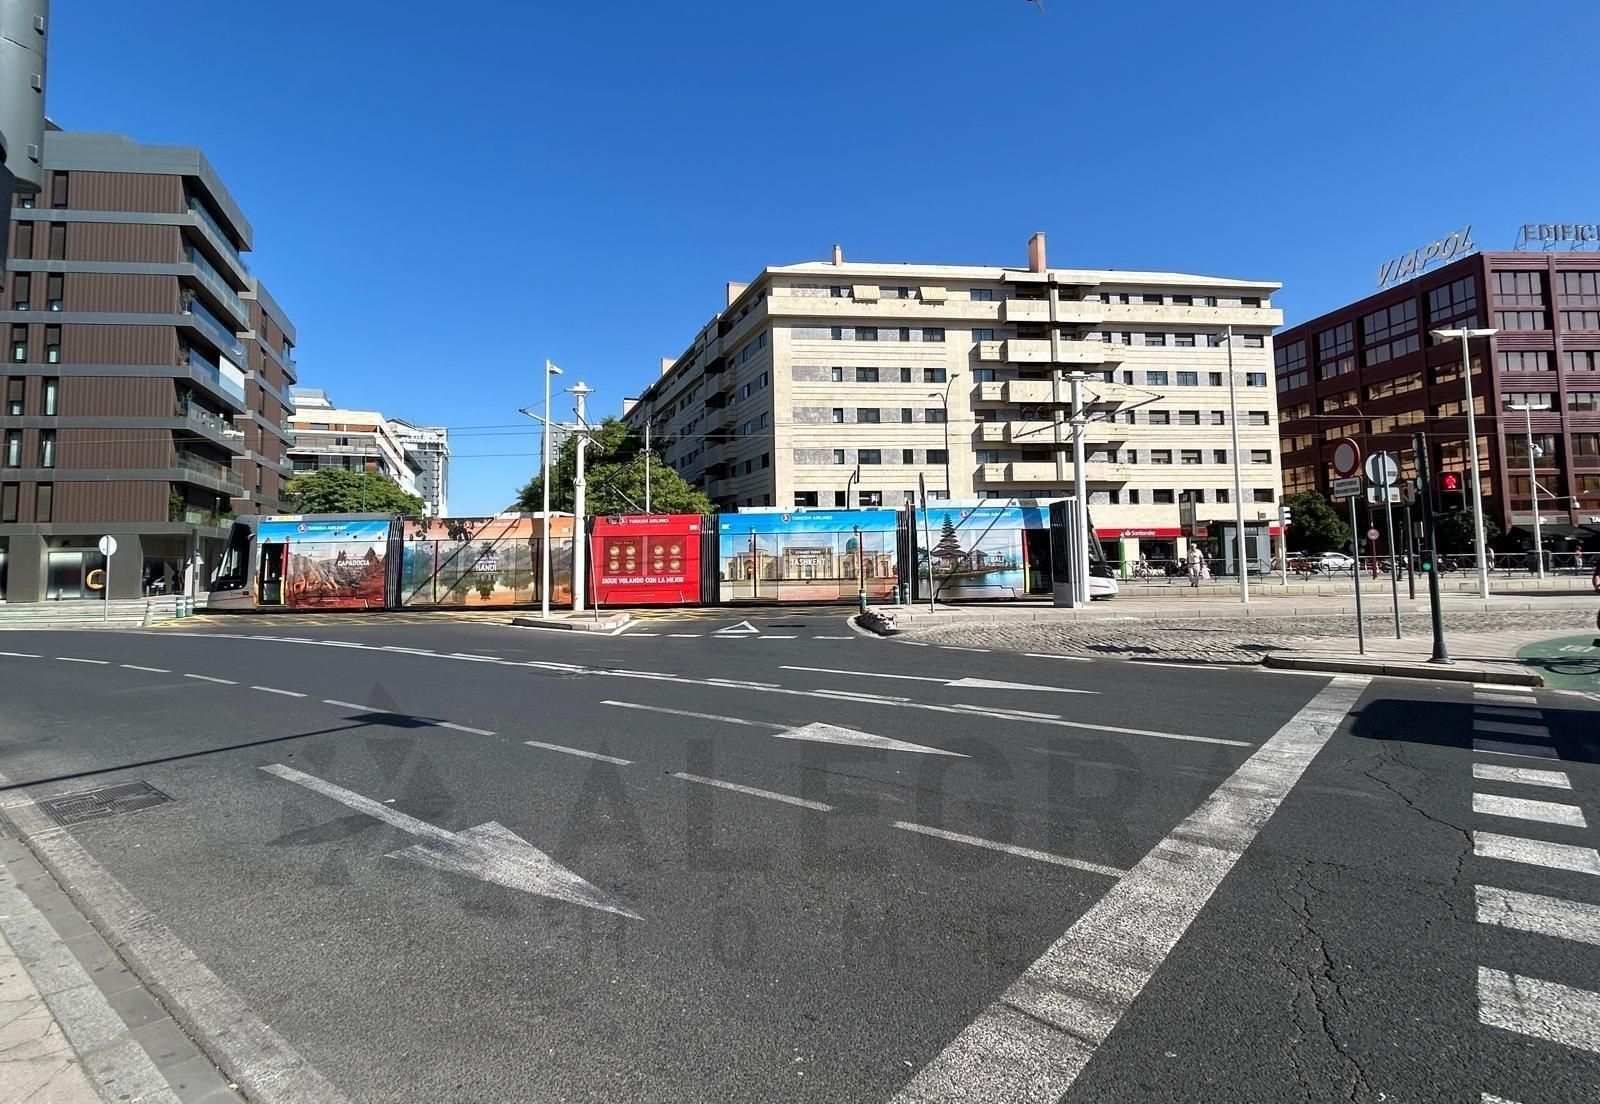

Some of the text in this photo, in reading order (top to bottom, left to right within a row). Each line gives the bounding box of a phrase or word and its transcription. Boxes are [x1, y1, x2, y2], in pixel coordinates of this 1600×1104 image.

[1376, 225, 1473, 287] VIAPOL
[337, 559, 370, 567] CAPADOCIA
[791, 558, 826, 566] TASHKENT
